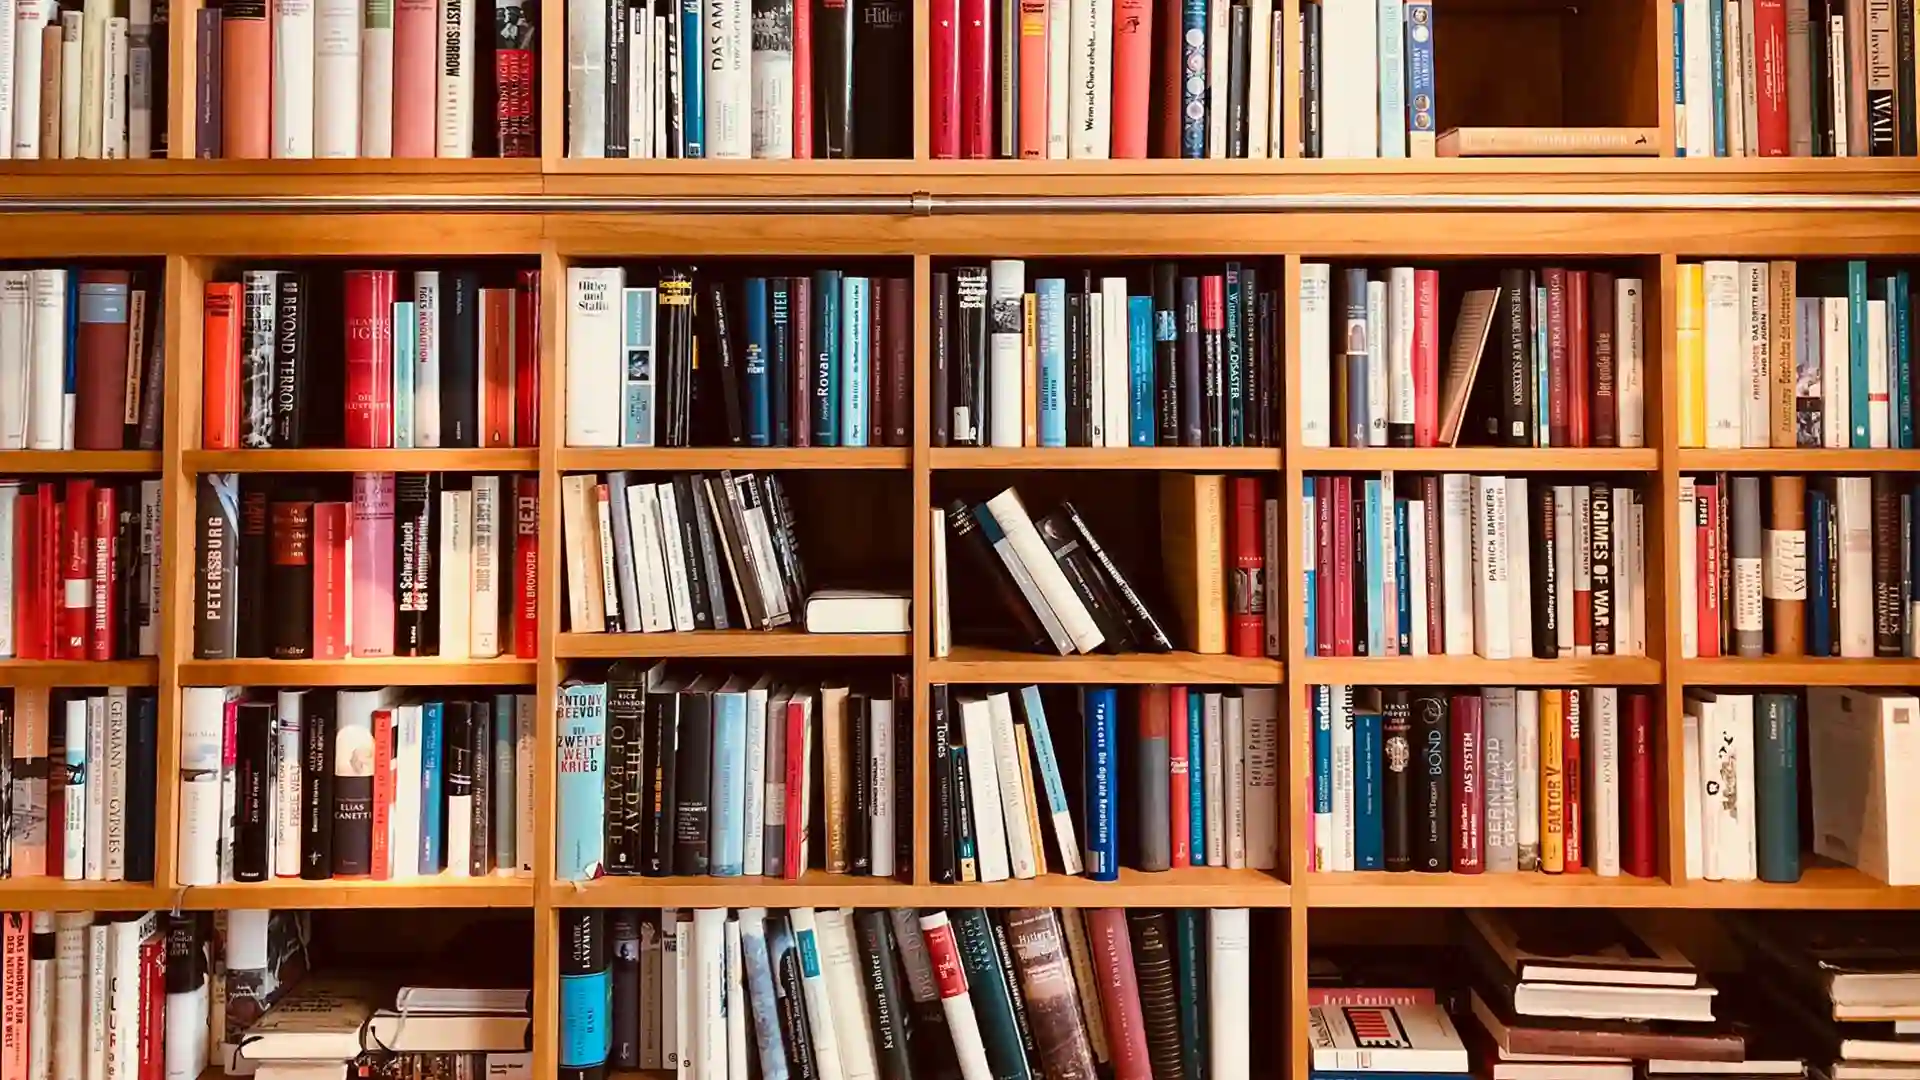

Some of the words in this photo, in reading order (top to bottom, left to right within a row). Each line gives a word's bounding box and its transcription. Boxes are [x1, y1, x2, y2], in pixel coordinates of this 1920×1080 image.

[864, 7, 904, 24] Hitler
[1870, 1, 1890, 24] The
[446, 31, 461, 77] SORROW
[712, 35, 723, 70] DAS
[1870, 27, 1891, 86] Invisible
[1085, 67, 1096, 89] China
[1085, 90, 1095, 106] sich
[1085, 106, 1095, 131] Wenn
[1872, 95, 1893, 149] WALL
[578, 281, 608, 291] Hitler
[1511, 288, 1521, 302] THE
[1750, 268, 1759, 292] REICH
[419, 286, 429, 309] FIGES
[578, 301, 609, 311] Stalin
[584, 292, 604, 301] und
[772, 291, 788, 325] TÄTER
[1550, 273, 1562, 323] ISLAMICA
[1751, 295, 1759, 322] DRITTE
[281, 297, 298, 353] BEYOND
[1226, 292, 1239, 338] Witnessing
[1511, 303, 1521, 332] ISLAMIC
[419, 311, 429, 363] REVOLUTION
[1229, 340, 1239, 352] the
[1512, 333, 1522, 349] LAW
[1552, 326, 1563, 360] TERRA
[1596, 332, 1612, 355] Türke
[1751, 323, 1759, 341] DAS
[747, 366, 765, 374] VICHY
[1512, 350, 1522, 361] OF
[1760, 357, 1768, 377] UND
[280, 358, 295, 413] TERROR
[817, 353, 829, 397] Rovan
[1230, 354, 1241, 399] DISASTER
[1512, 362, 1522, 406] SUCCESSION
[1596, 382, 1612, 397] Der
[475, 487, 491, 502] THE
[475, 503, 491, 523] CASE
[518, 496, 534, 535] RED
[1486, 487, 1497, 536] BAHNERS
[1699, 497, 1707, 525] PIPER
[476, 524, 491, 533] OF
[1593, 500, 1609, 560] CRIMES
[400, 522, 413, 590] Schwarzbuch
[414, 515, 428, 590] Kommunismus
[1487, 539, 1498, 582] PATRICK
[206, 516, 223, 621] PETERSBURG
[525, 551, 537, 598] BROWDER
[1594, 564, 1608, 585] OF
[400, 592, 413, 611] Das
[415, 592, 428, 611] des
[1546, 584, 1555, 594] de
[526, 598, 537, 619] BILL
[1547, 595, 1556, 630] Geoffroy
[1593, 589, 1609, 627] WAR
[1878, 581, 1890, 635] JONATHAN
[1889, 583, 1901, 634] SCHELL
[557, 694, 602, 706] ANTONY
[936, 709, 944, 721] The
[1316, 685, 1330, 731] ampus
[1342, 685, 1354, 730] ampus
[1567, 689, 1580, 740] campus
[1097, 703, 1106, 747] Tapscott
[1602, 695, 1612, 737] LORENZ
[109, 701, 123, 770] GERMANY
[557, 735, 603, 747] ZWEITE
[610, 725, 624, 760] OF
[936, 722, 949, 758] Tories
[1248, 716, 1261, 750] Packer
[561, 760, 598, 773] KRIEG
[564, 747, 596, 760] WELT
[626, 737, 641, 781] THE
[1098, 752, 1107, 765] Die
[1428, 730, 1442, 775] BOND
[1462, 732, 1474, 771] SYSTEM
[1602, 739, 1612, 784] KONRAD
[251, 771, 260, 797] Freiheit
[288, 754, 298, 783] WELT
[1096, 766, 1107, 796] digitale
[1249, 754, 1262, 787] George
[1464, 773, 1475, 793] DAS
[1545, 766, 1559, 777] V
[289, 785, 299, 817] FREIE
[340, 803, 365, 811] ELIAS
[609, 765, 625, 846] BATTLE
[1487, 736, 1502, 847] BERNHARD
[1503, 759, 1516, 847] GRZIMEK
[1547, 780, 1561, 834] FAKTOR
[108, 799, 122, 854] GYPSIES
[252, 809, 260, 823] Zeit
[334, 812, 372, 820] CANETTI
[624, 792, 640, 834] DAY
[1098, 798, 1108, 843] Revolution
[1429, 820, 1438, 843] Lynne
[6, 934, 15, 954] DEN
[15, 934, 25, 953] DAS
[573, 924, 582, 961] CLAUDE
[582, 915, 591, 968] LANZMANN
[5, 956, 15, 1002] NEUSTART
[15, 955, 25, 1004] HANDBUCH
[872, 955, 883, 990] Bohrer
[5, 1004, 14, 1023] DER
[15, 1006, 25, 1025] FÜR
[878, 994, 889, 1024] Heinz
[5, 1024, 14, 1049] WELT
[94, 1027, 104, 1053] Roger
[880, 1027, 894, 1049] Karl
